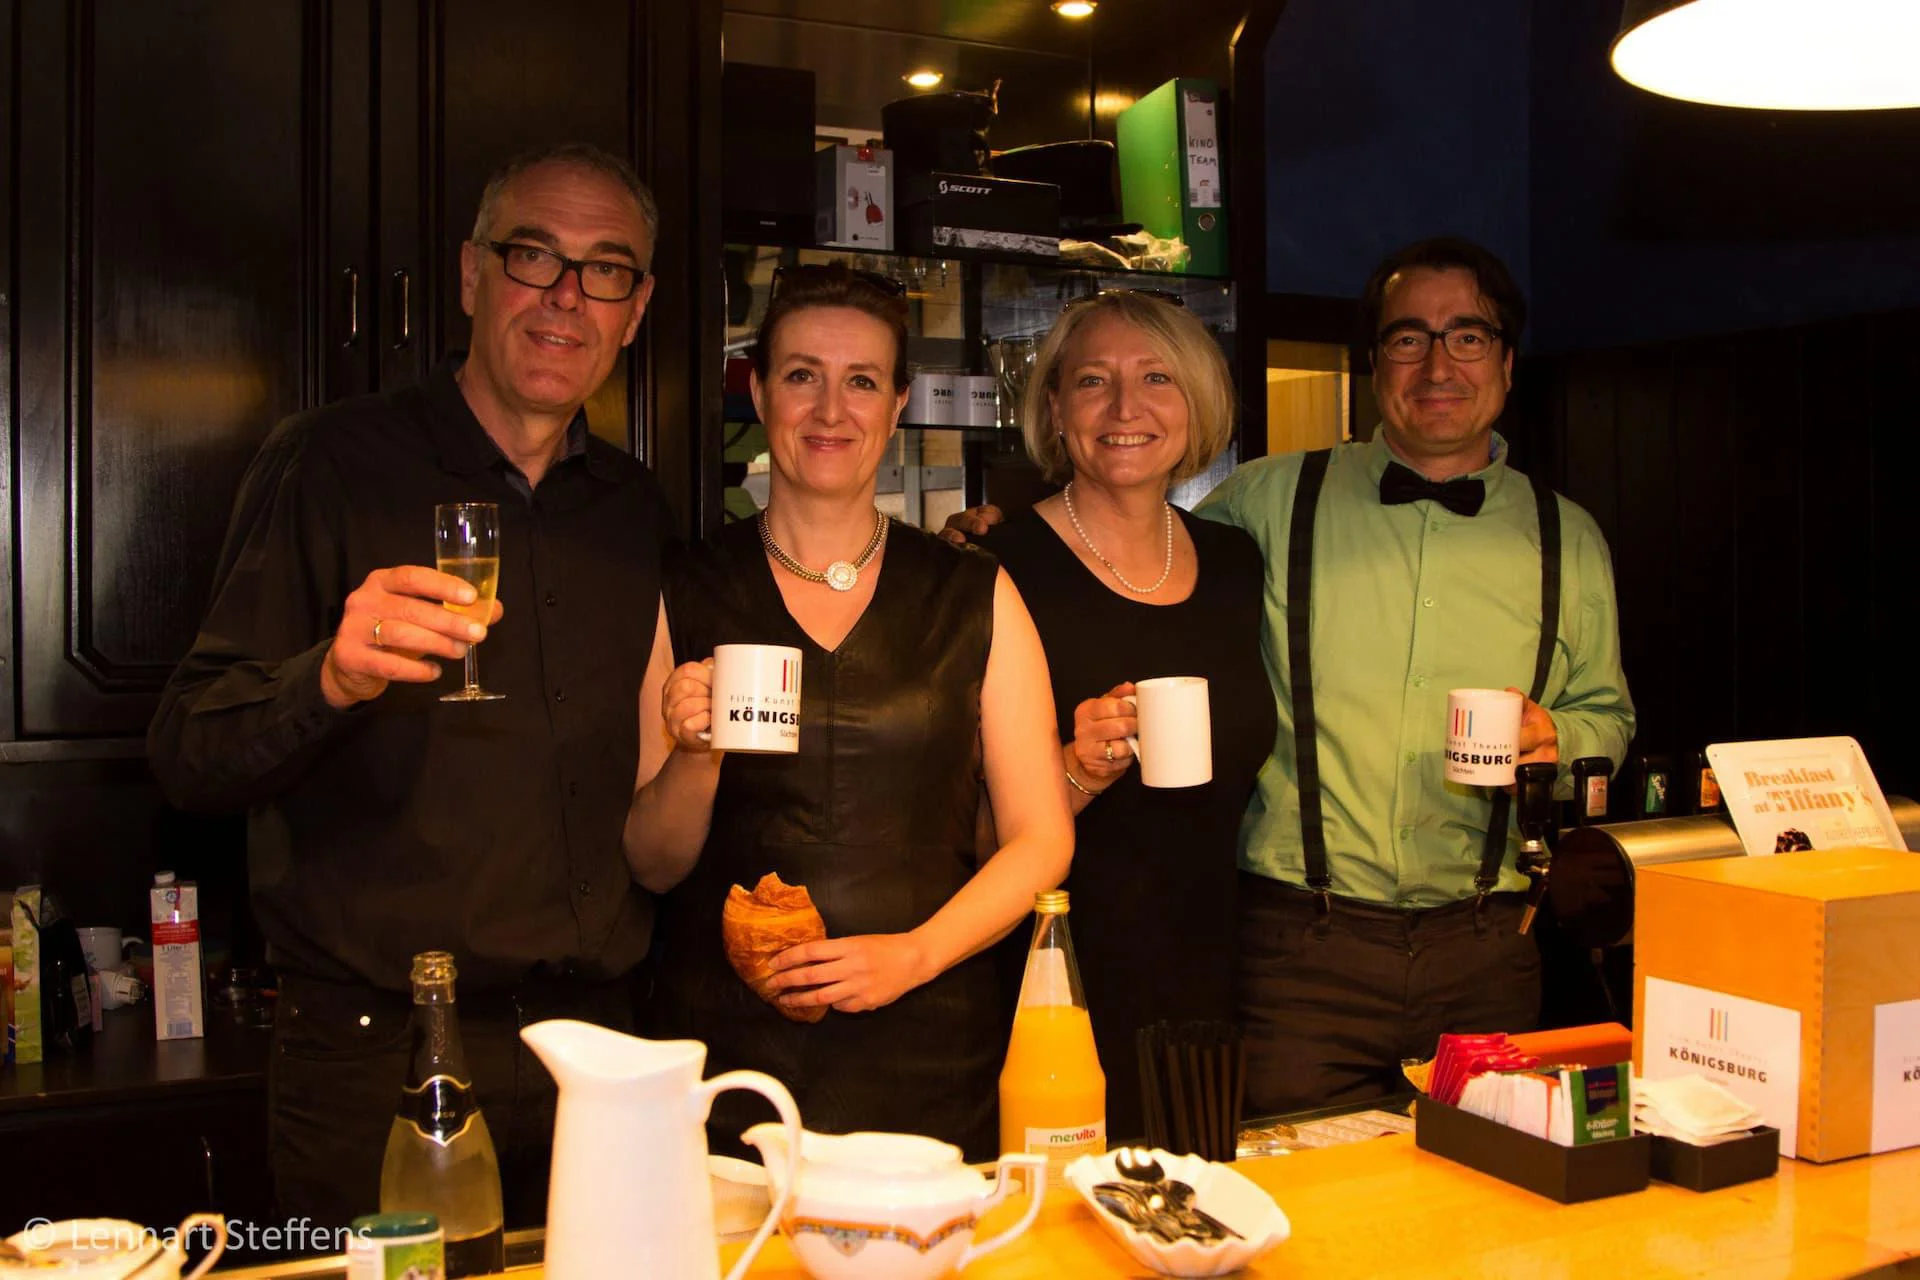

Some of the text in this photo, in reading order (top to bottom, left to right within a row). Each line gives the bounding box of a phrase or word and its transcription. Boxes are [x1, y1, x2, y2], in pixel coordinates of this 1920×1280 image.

[1189, 136, 1214, 149] KINO
[1189, 155, 1216, 167] TEAM
[949, 184, 992, 194] SCOTT
[765, 696, 794, 706] Kunst
[1744, 768, 1837, 788] Breakfast
[1753, 785, 1873, 814] at Tiffany's
[1669, 1046, 1768, 1083] KÖNIGSBURG
[1049, 1128, 1096, 1143] mervita
